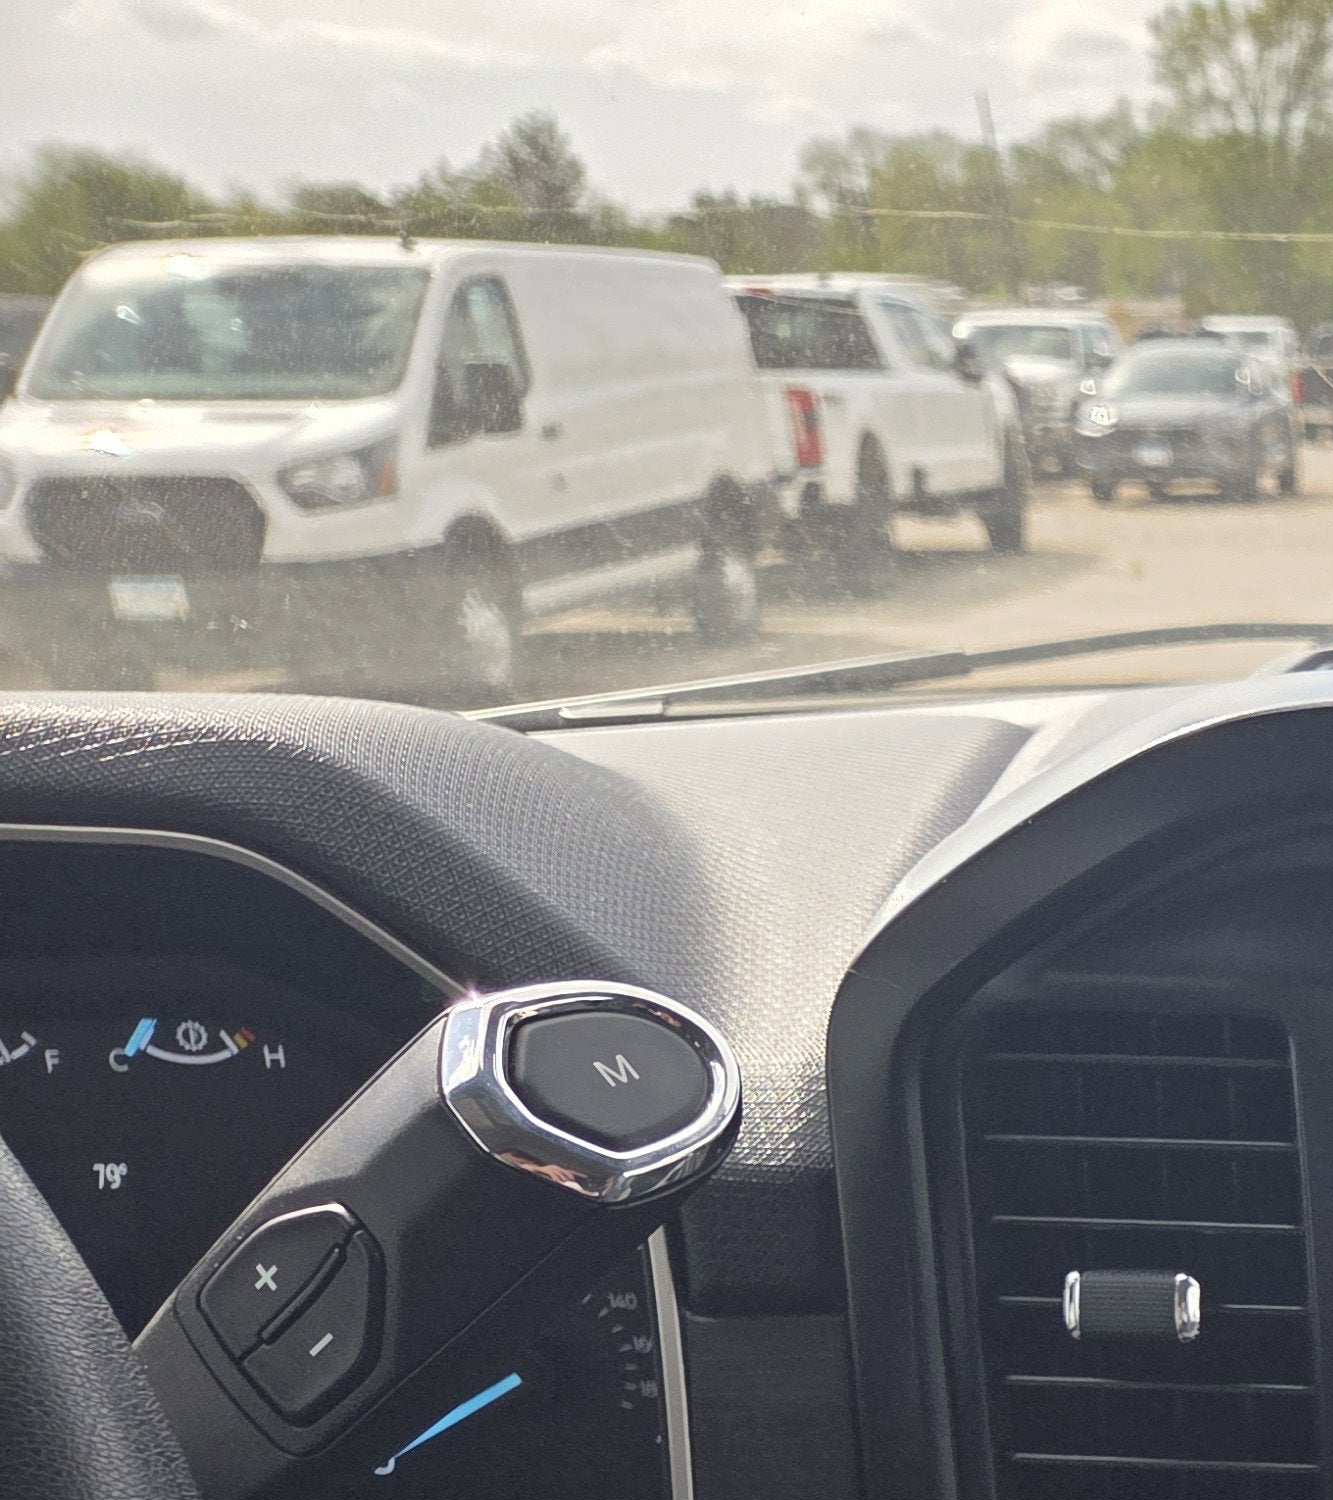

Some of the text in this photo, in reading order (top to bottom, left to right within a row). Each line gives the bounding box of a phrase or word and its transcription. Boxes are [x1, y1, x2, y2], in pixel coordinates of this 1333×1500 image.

[44, 1048, 61, 1074] F
[263, 1043, 286, 1069] H
[593, 1053, 640, 1087] M
